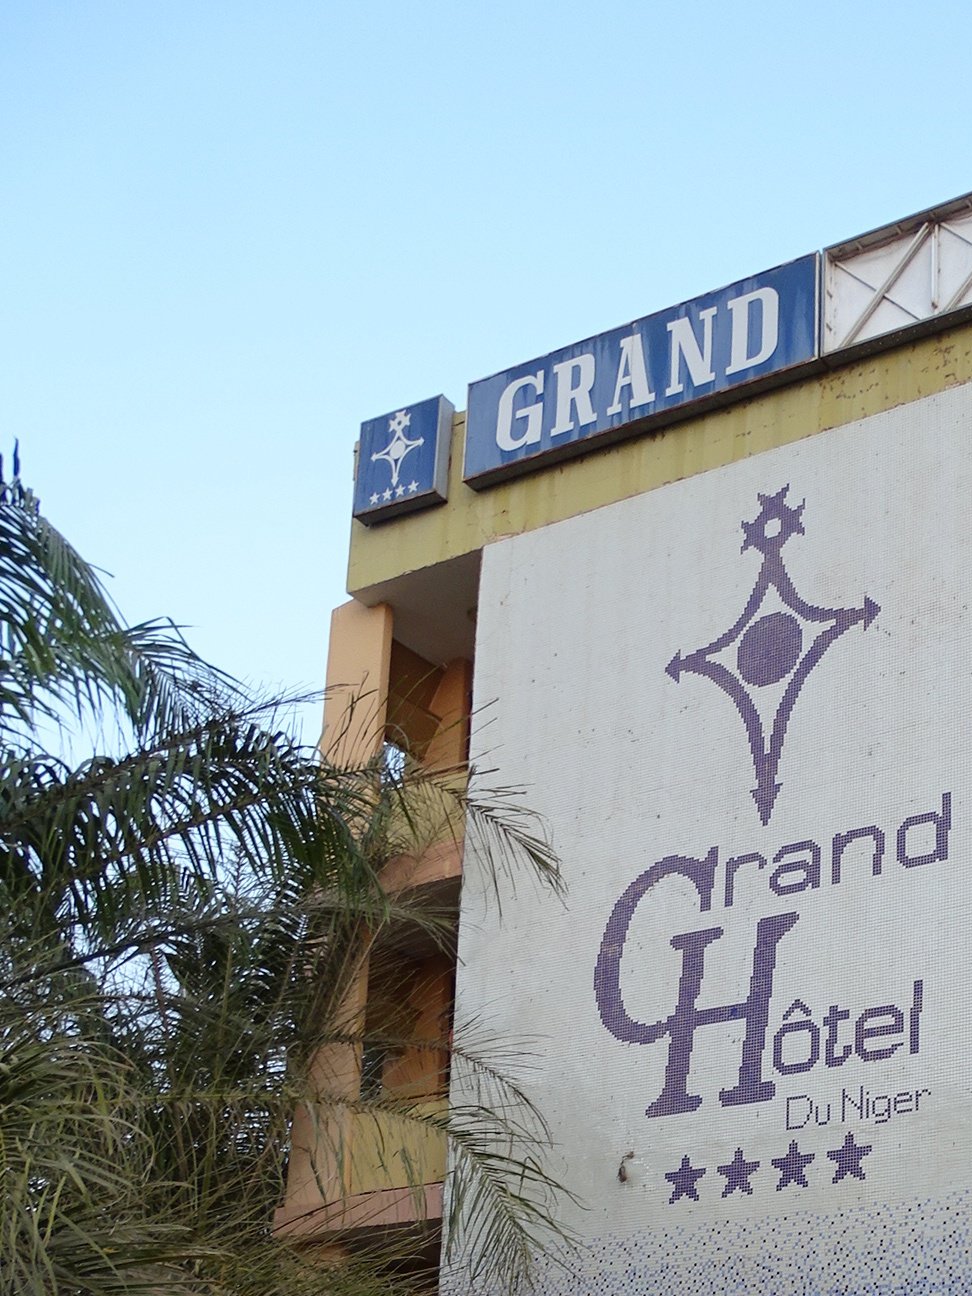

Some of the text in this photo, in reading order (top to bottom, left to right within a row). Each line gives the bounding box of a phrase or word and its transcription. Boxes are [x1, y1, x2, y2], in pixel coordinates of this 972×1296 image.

[495, 286, 780, 453] GRAND
[594, 791, 952, 1046] Grand
[645, 911, 924, 1118] Hôtel
[785, 1085, 932, 1131] Du Niger
